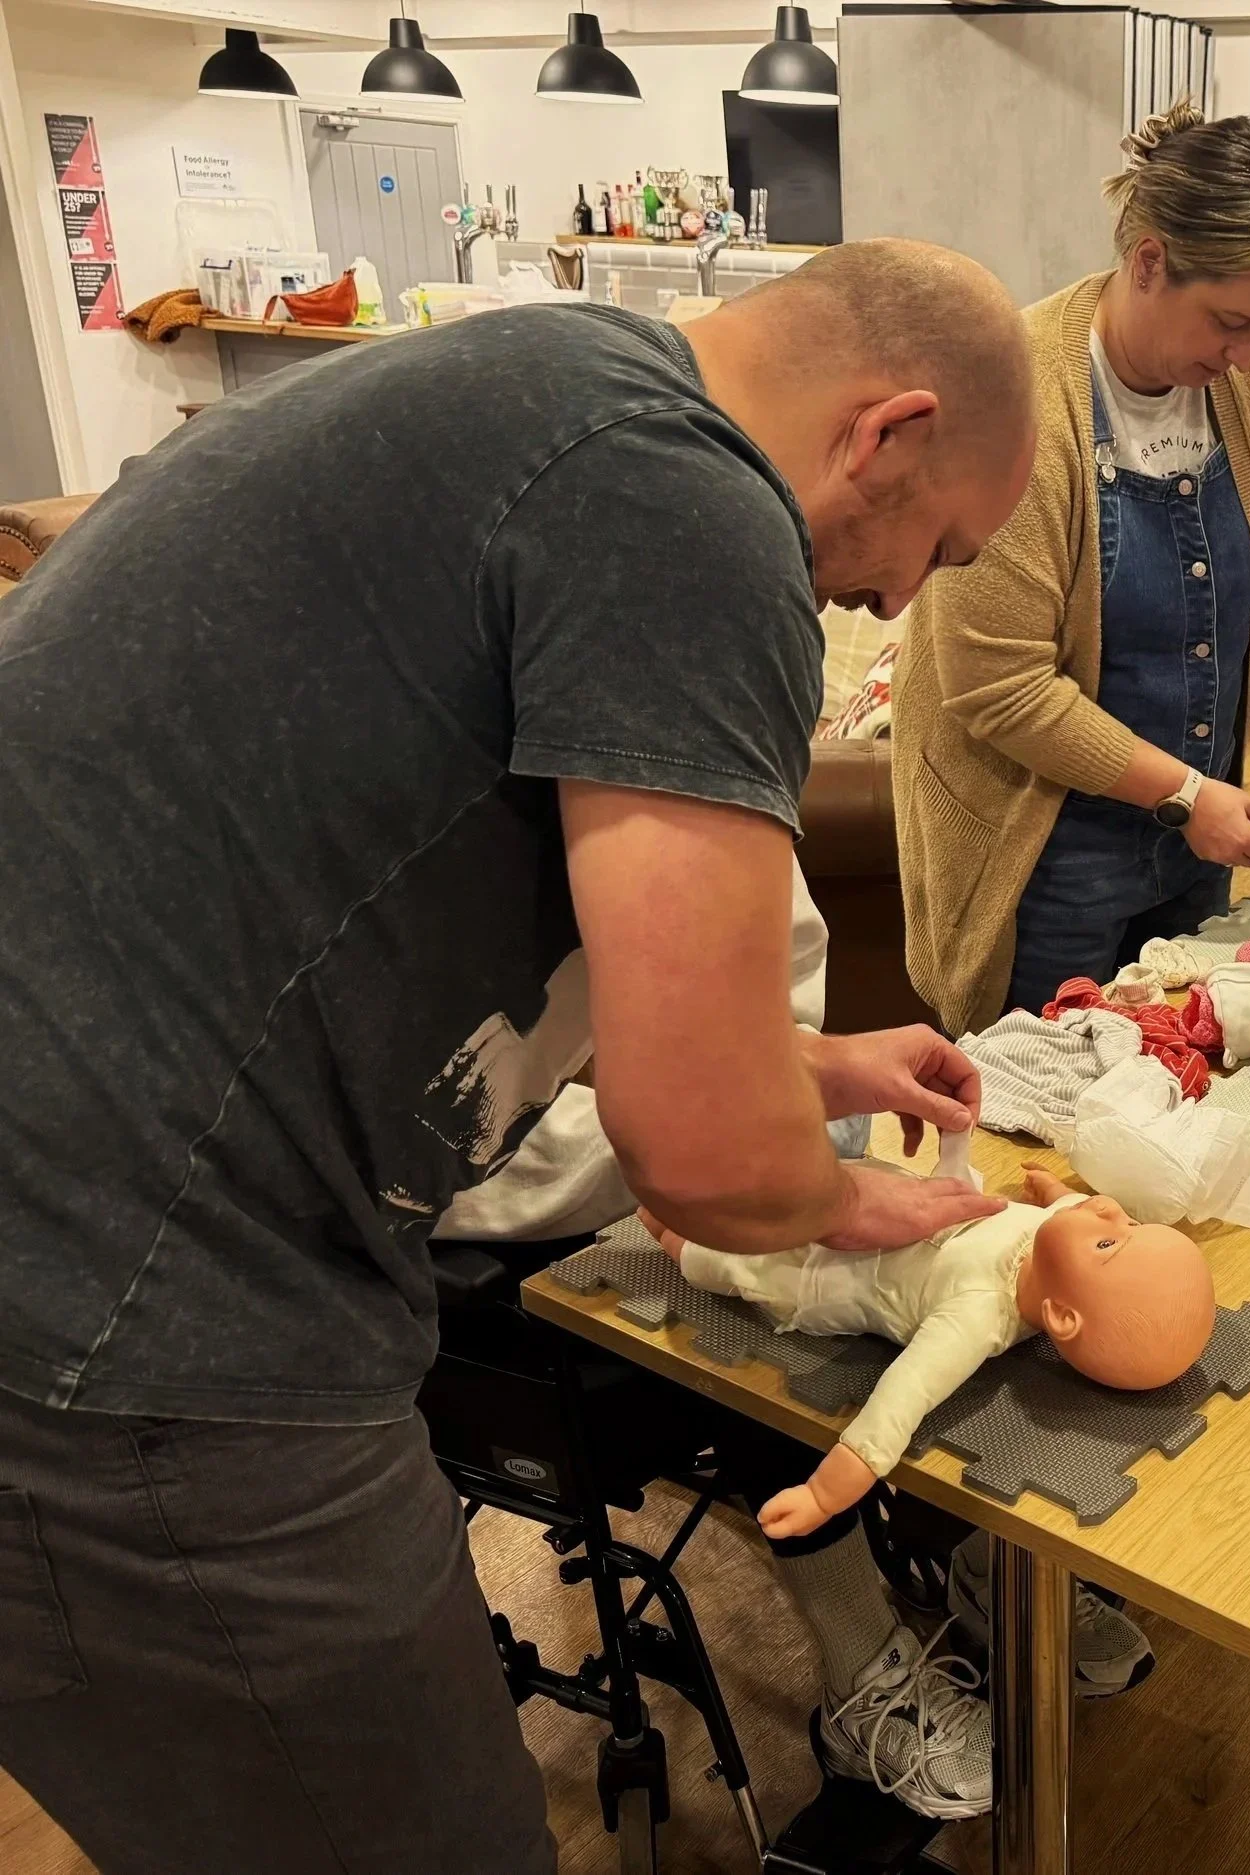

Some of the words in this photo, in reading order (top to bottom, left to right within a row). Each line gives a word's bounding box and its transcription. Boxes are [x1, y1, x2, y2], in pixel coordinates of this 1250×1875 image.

[184, 155, 202, 164] Food
[203, 156, 229, 167] Allergy
[185, 169, 231, 179] Intolerance?
[62, 191, 97, 204] UNDER
[63, 201, 81, 213] 25?
[508, 1459, 542, 1478] Lomax
